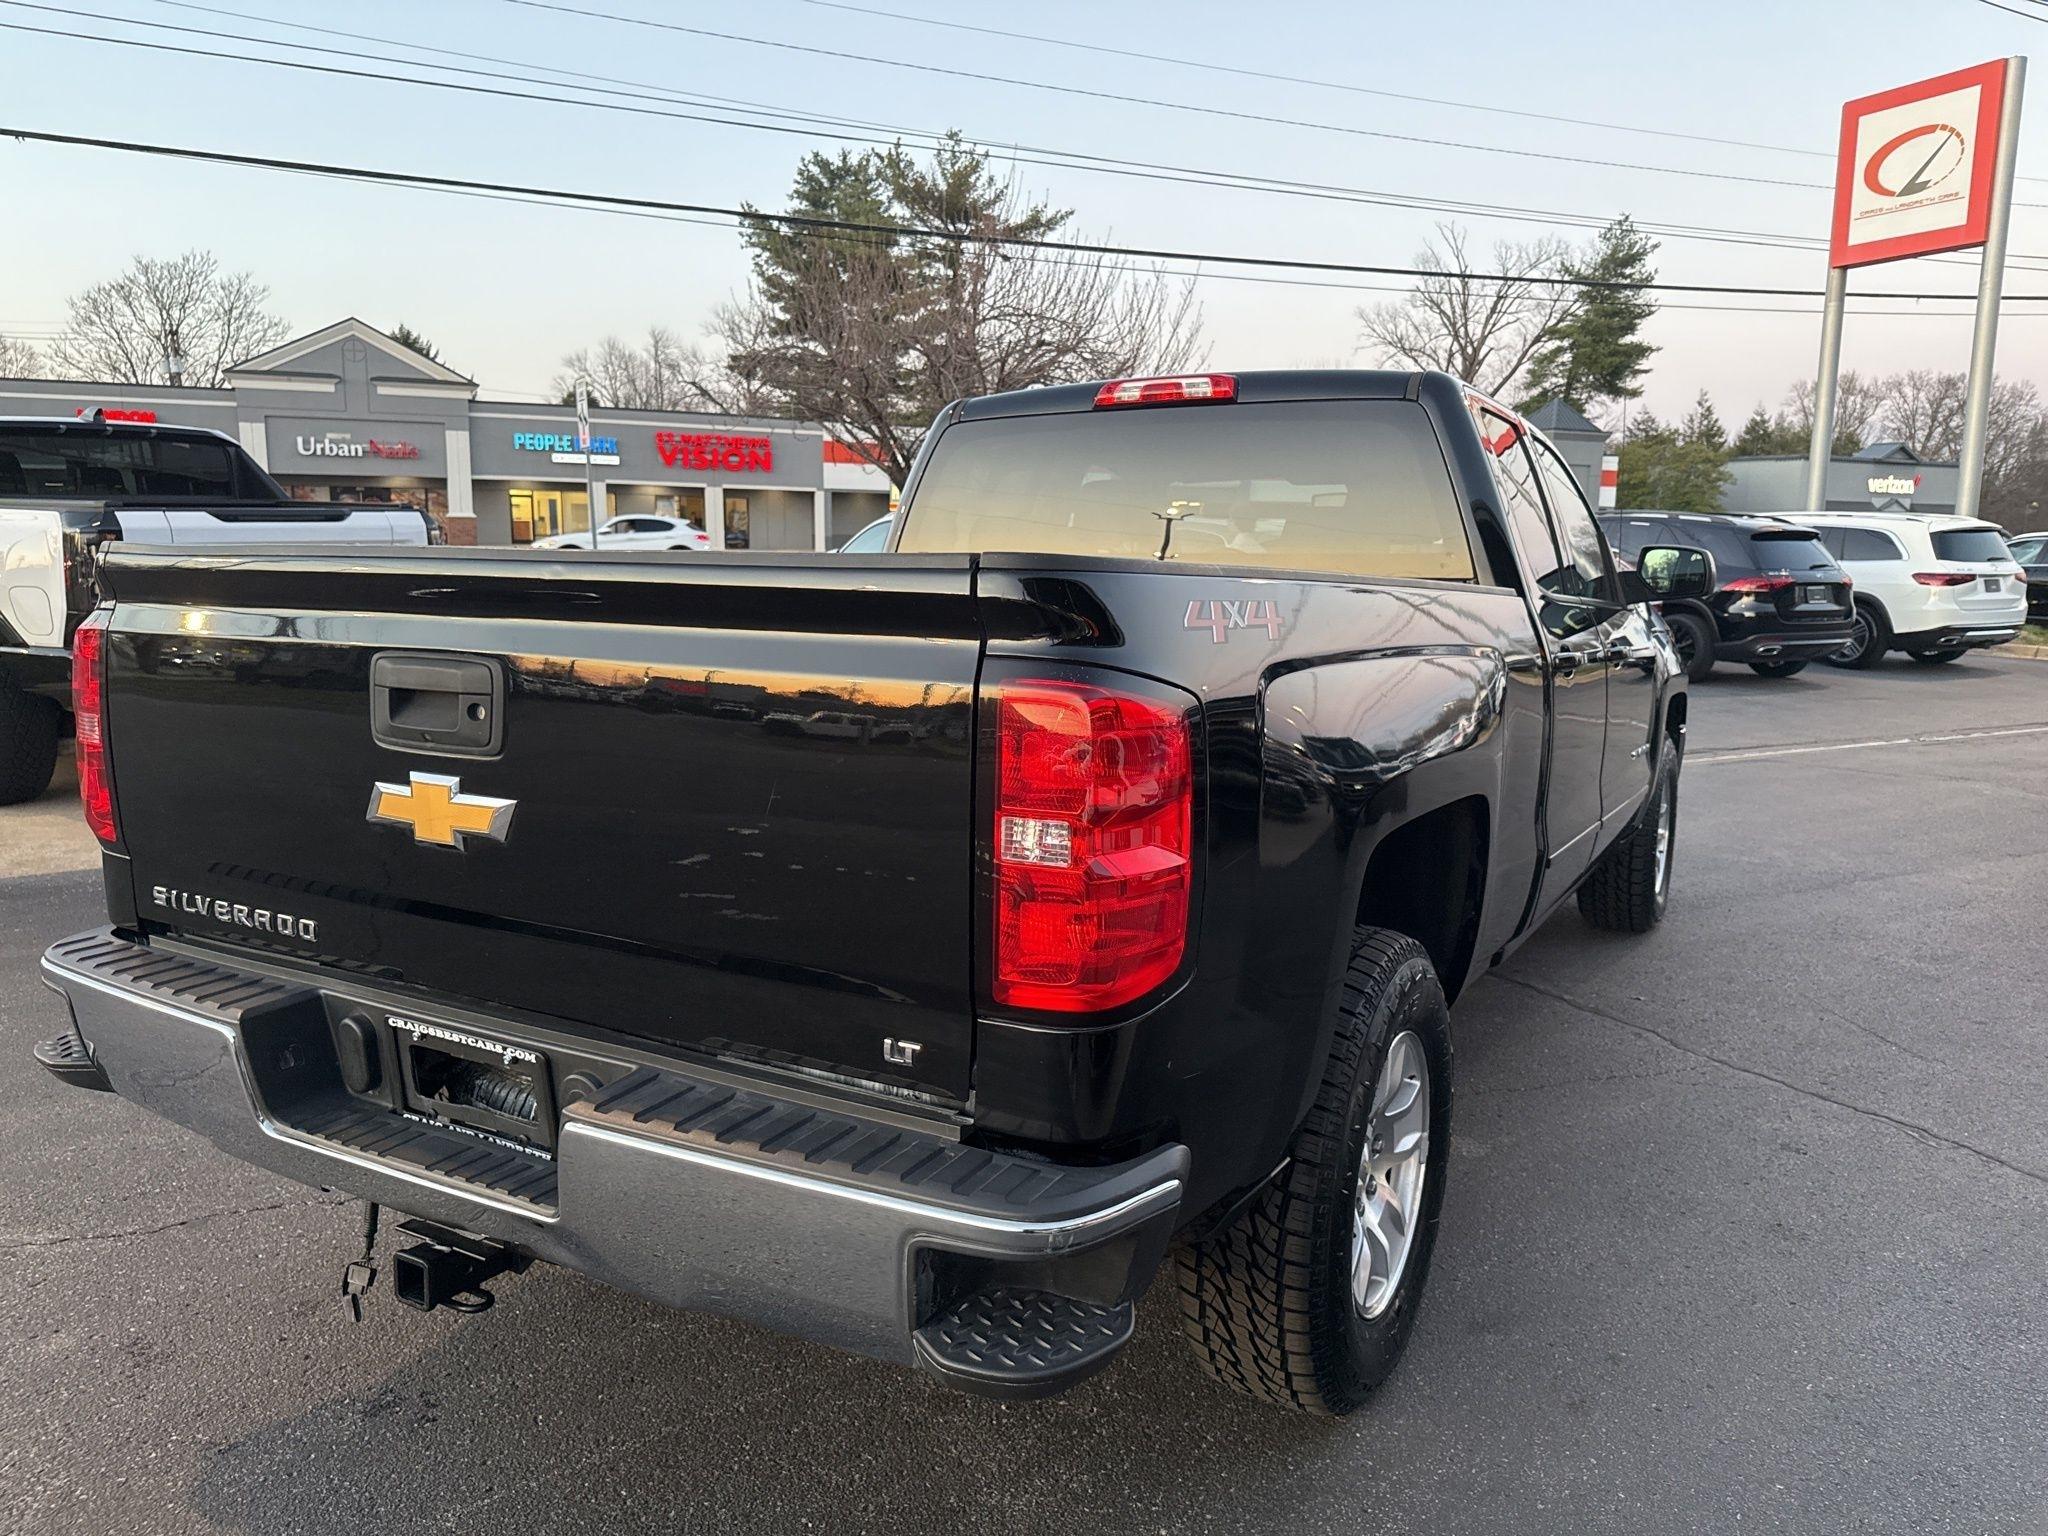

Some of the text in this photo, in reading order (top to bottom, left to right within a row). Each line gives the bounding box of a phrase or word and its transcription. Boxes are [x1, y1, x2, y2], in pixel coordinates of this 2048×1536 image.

[296, 436, 363, 456] Urban
[656, 445, 773, 472] VISION
[1867, 475, 1915, 495] verizon
[153, 885, 318, 943] SILVERADO
[388, 1017, 537, 1064] CRAIGSBESTCARS.COM
[883, 1037, 922, 1066] LT
